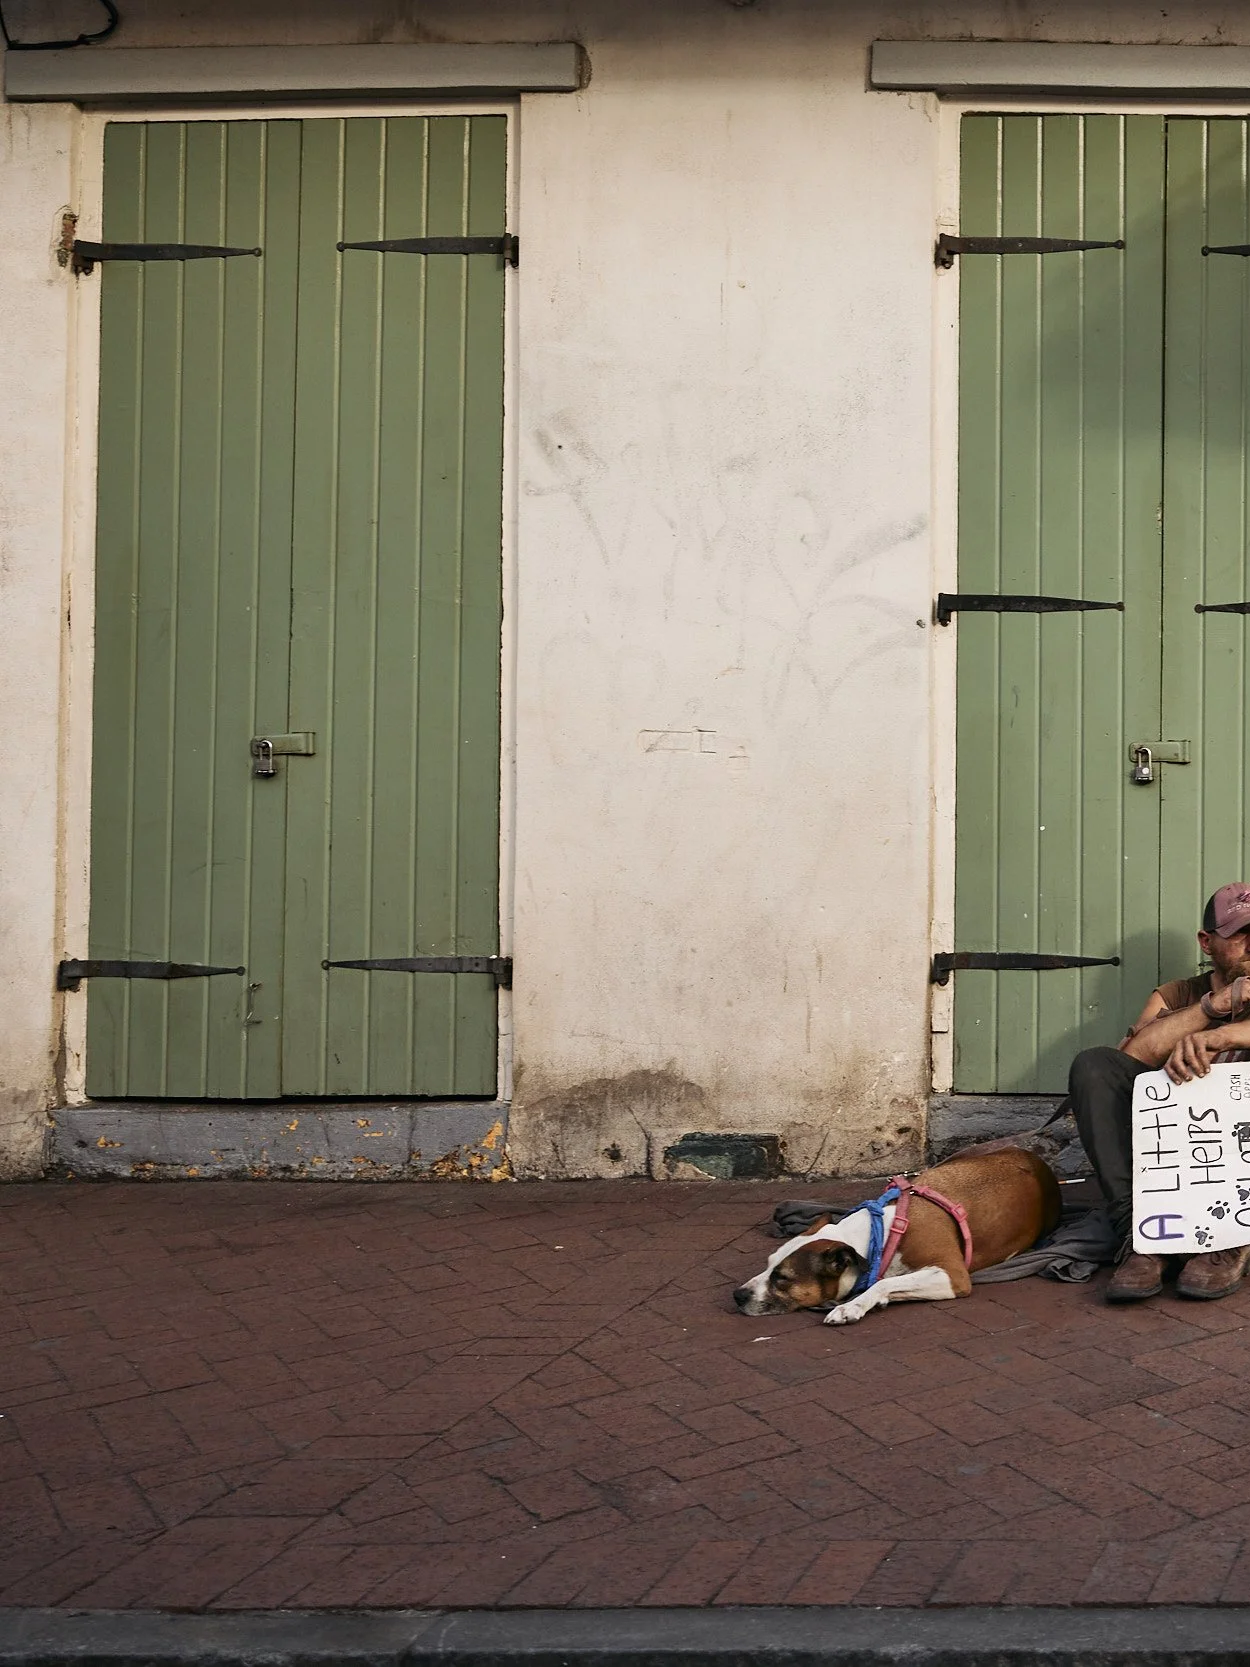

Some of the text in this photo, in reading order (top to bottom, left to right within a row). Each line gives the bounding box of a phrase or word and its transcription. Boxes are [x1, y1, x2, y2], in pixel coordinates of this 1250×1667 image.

[1229, 1074, 1242, 1101] CASH
[1138, 1082, 1185, 1241] A Little
